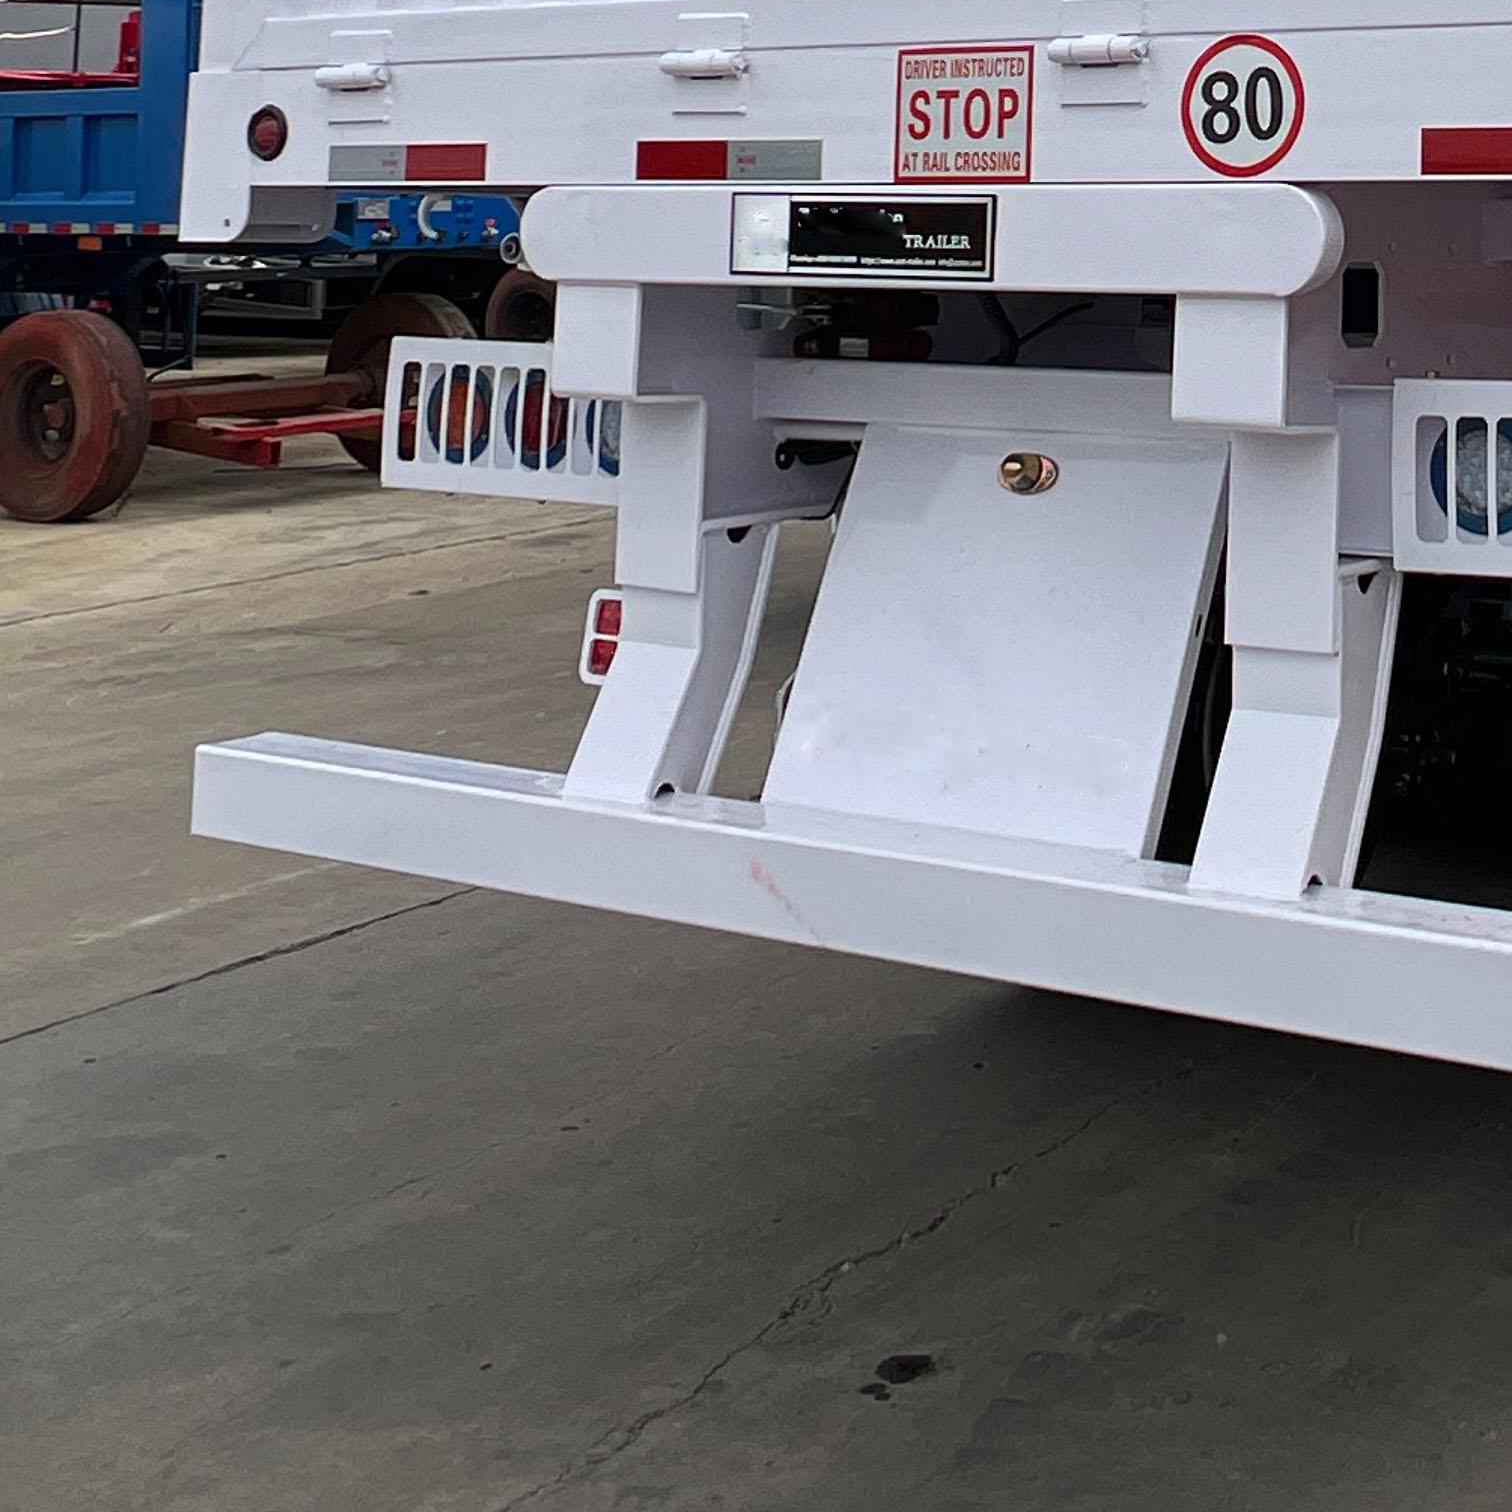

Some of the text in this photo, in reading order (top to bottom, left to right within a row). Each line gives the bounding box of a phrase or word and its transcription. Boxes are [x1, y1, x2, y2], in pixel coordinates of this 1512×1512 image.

[904, 57, 1025, 80] DRIVER INSTRUCTED
[907, 88, 1019, 140] STOP
[1201, 66, 1283, 143] 80
[902, 151, 1021, 172] AT RAIL CROSSING
[903, 234, 971, 249] TRAILER
